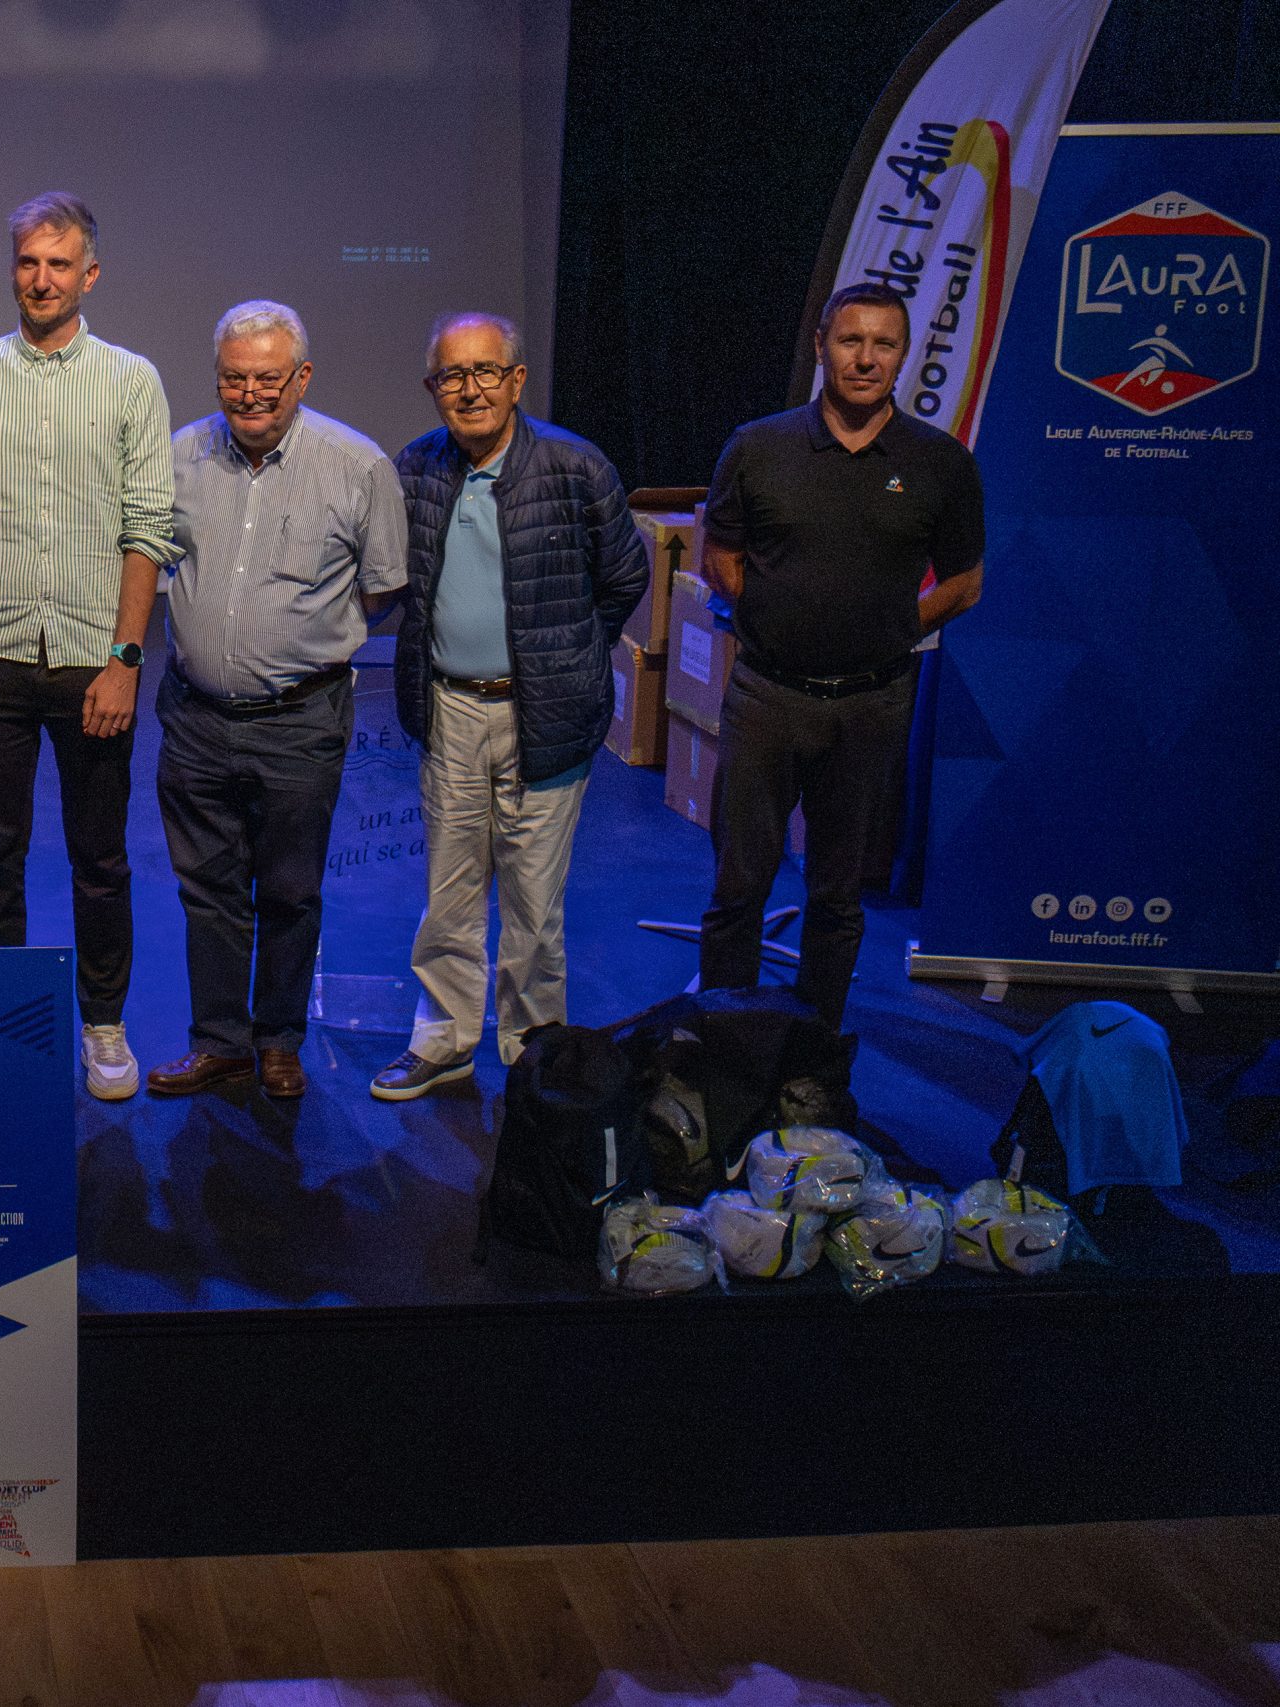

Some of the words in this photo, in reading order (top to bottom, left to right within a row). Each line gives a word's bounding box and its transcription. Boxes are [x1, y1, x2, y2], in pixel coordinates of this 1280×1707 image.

[877, 122, 958, 230] l'Ain
[1154, 202, 1188, 215] FFF
[1174, 299, 1246, 314] Foot
[1126, 444, 1190, 459] FOOTBALL
[359, 810, 392, 831] un
[327, 840, 370, 877] qui
[376, 842, 402, 862] se
[1049, 930, 1168, 947] laurafoot.fff.fr
